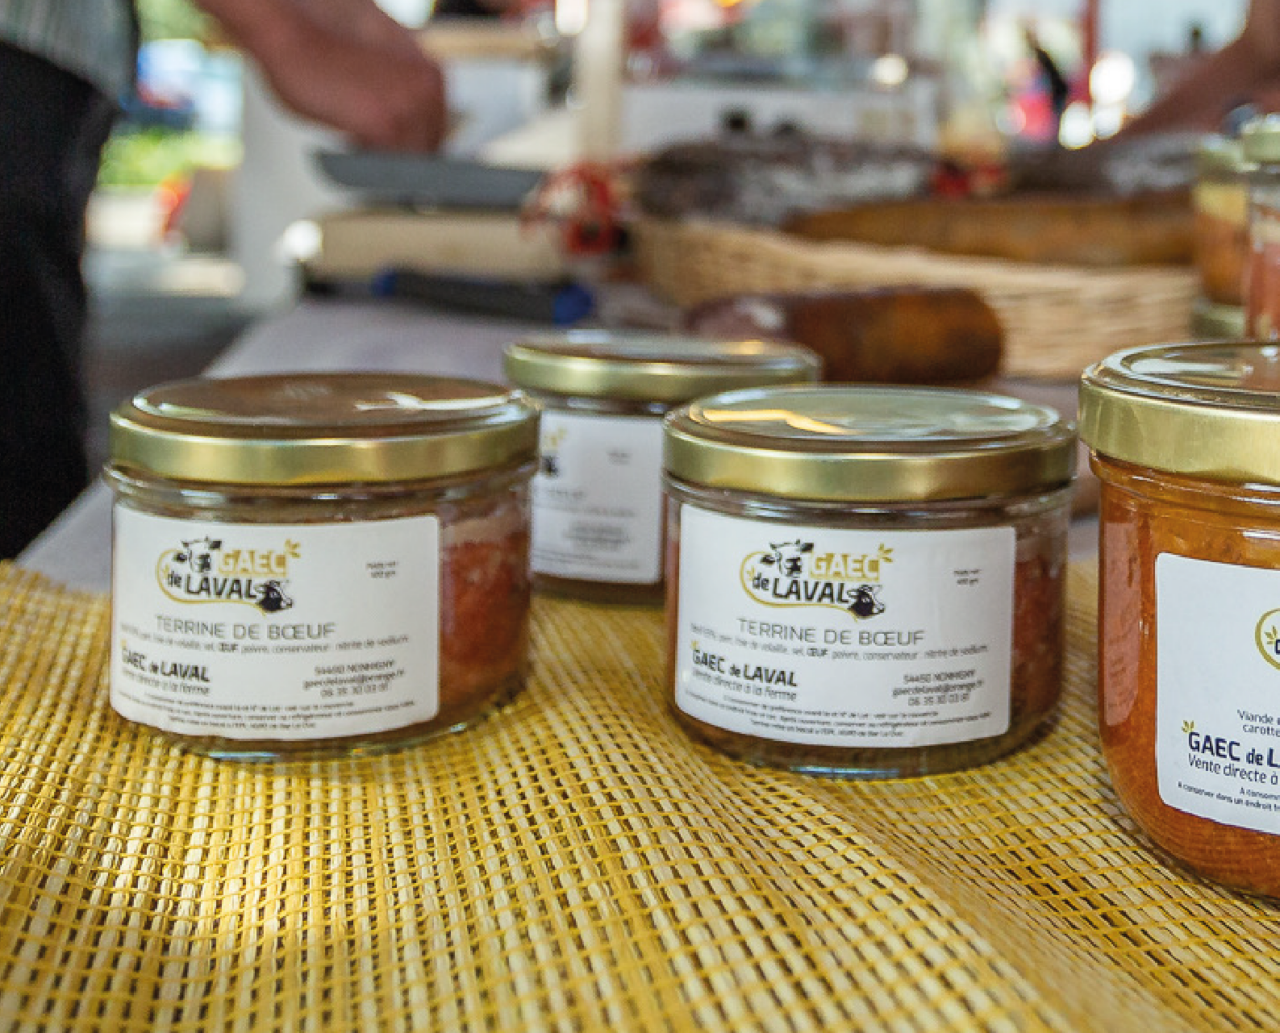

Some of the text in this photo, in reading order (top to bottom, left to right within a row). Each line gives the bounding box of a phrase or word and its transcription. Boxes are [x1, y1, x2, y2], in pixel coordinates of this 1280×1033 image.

[219, 550, 286, 576] GAEC
[810, 552, 880, 580] GAEC
[185, 574, 257, 600] LAVAL
[752, 572, 850, 605] de LAVAL
[156, 615, 226, 639] TERRINE
[233, 623, 260, 640] DE
[267, 622, 336, 641] BŒUF
[737, 617, 816, 644] TERRINE
[824, 628, 851, 646] DE
[859, 629, 926, 647] BŒUF
[160, 660, 211, 683] LAVAL
[692, 649, 725, 675] GAEC
[744, 664, 798, 688] LAVAL
[1237, 708, 1273, 726] Viande
[1188, 731, 1241, 762] GAEC
[1246, 748, 1264, 766] de
[1188, 753, 1221, 775] Vente
[1223, 762, 1267, 785] directe
[1270, 770, 1280, 787] à
